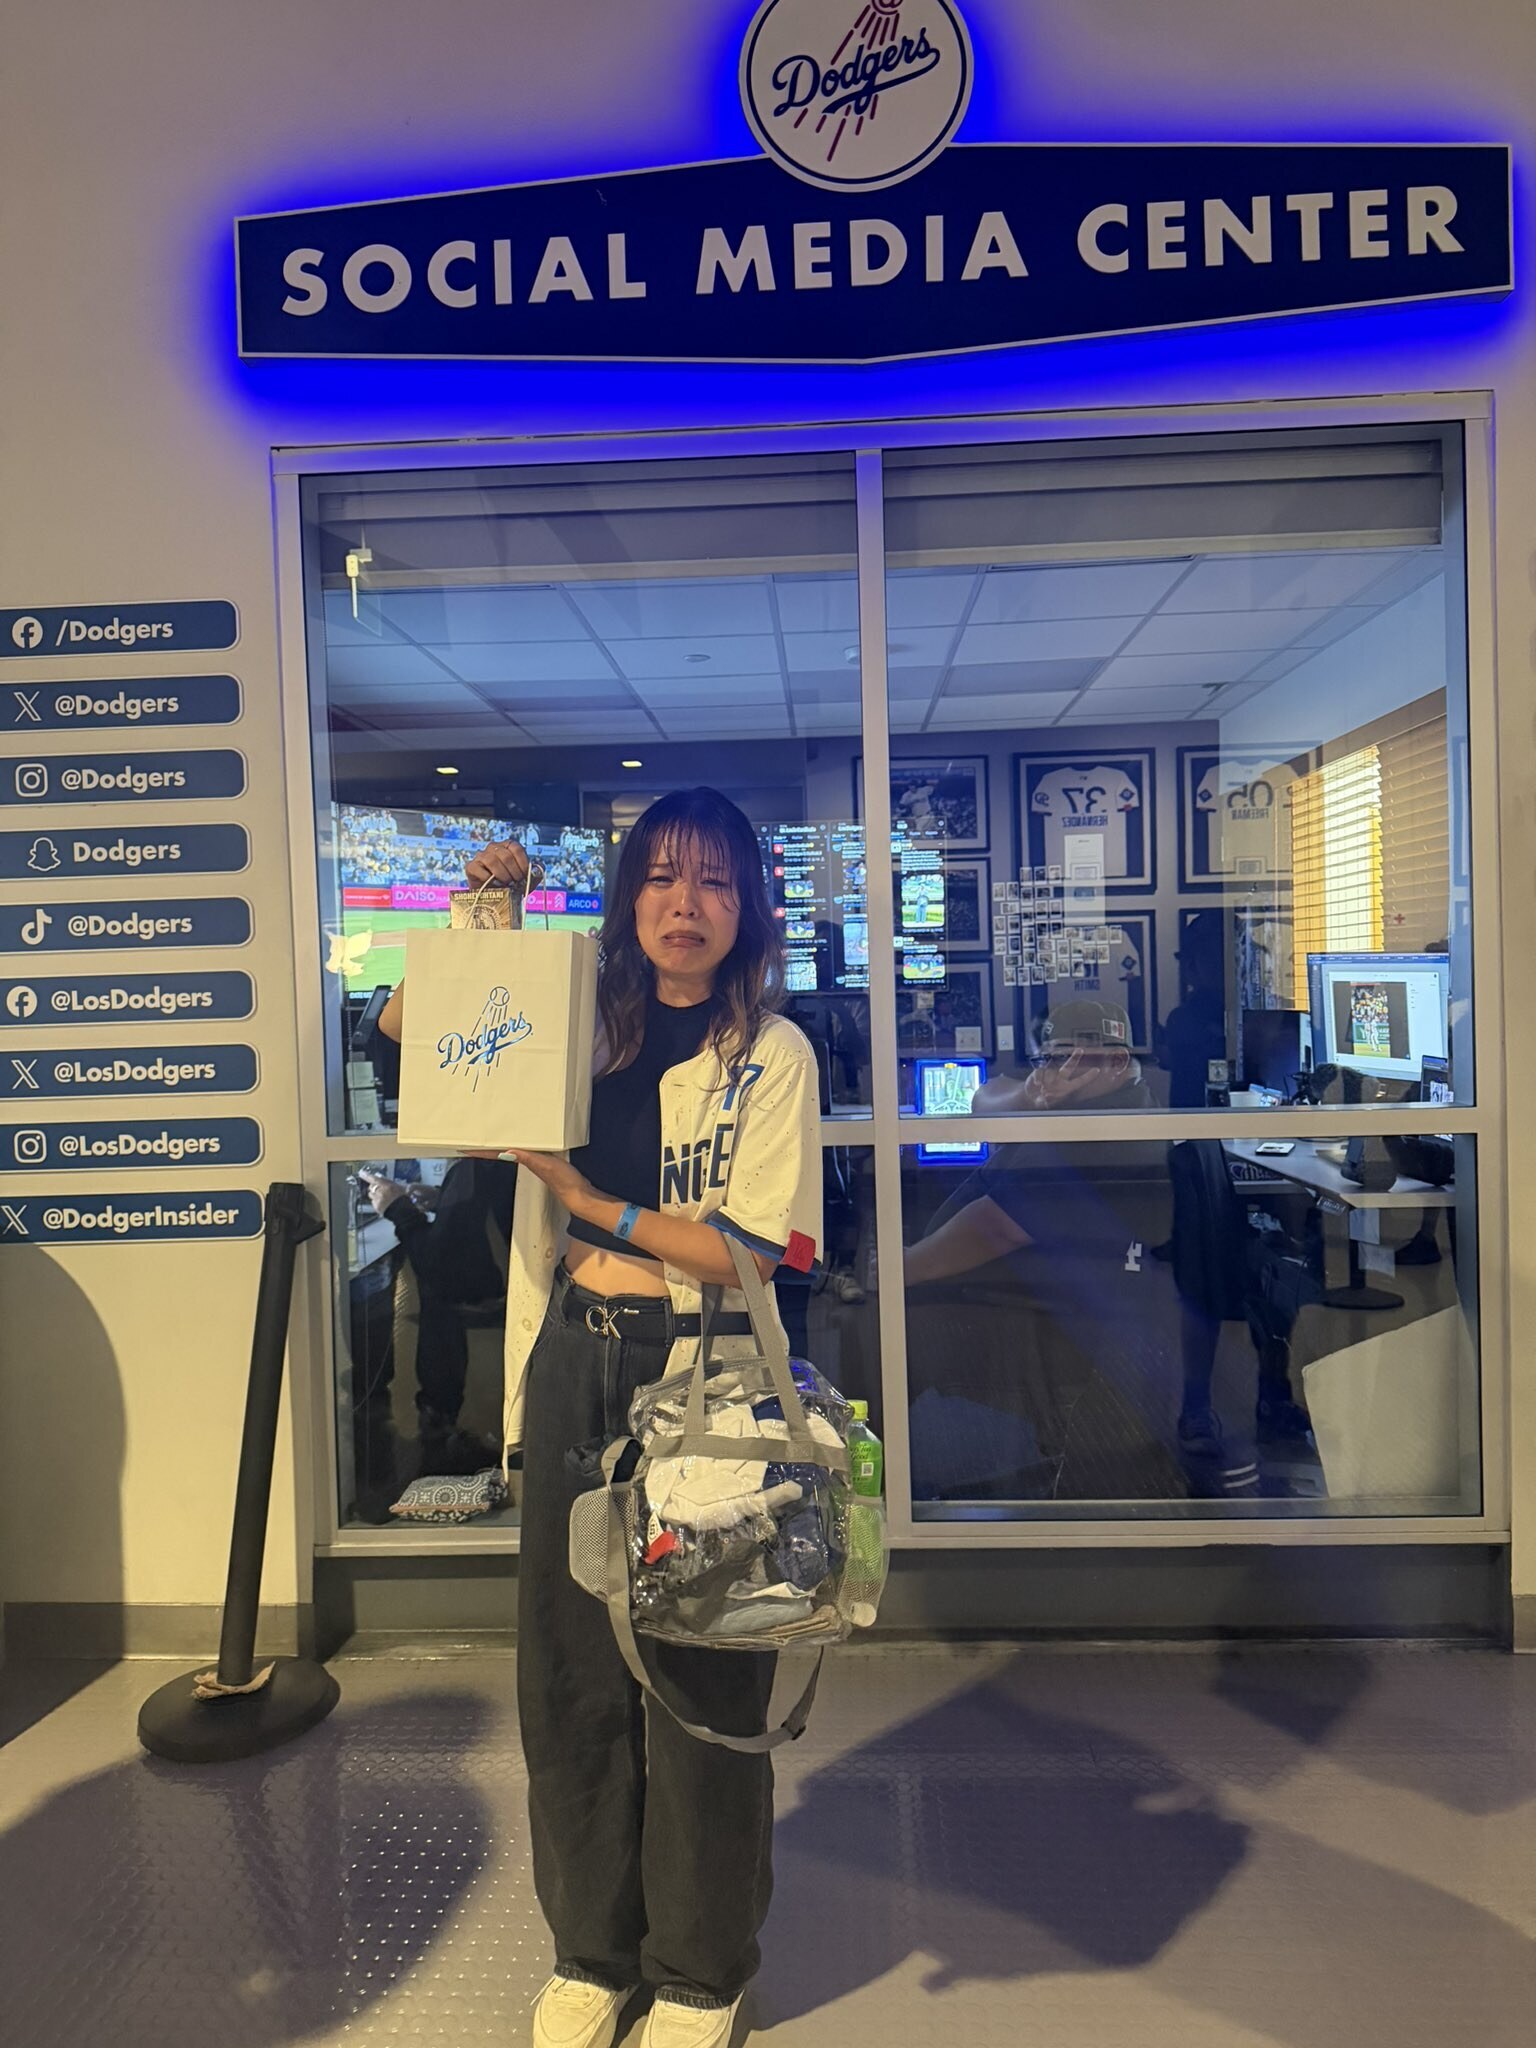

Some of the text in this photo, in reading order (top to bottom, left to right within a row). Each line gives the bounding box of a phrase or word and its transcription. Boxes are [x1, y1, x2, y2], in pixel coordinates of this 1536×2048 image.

[771, 26, 941, 118] Dodgers
[281, 185, 1465, 317] SOCIAL MEDIA CENTER
[55, 617, 174, 647] /Dodgers
[54, 691, 179, 720] @Dodgers
[61, 765, 186, 794] @Dodgers
[73, 838, 181, 867] Dodgers
[395, 890, 436, 902] DAISO
[568, 899, 592, 909] ARCO
[67, 912, 193, 940] @Dodgers
[51, 985, 213, 1014] @LosDodgers
[437, 1011, 533, 1069] Dodgers
[54, 1057, 216, 1086] @LosDodgers
[59, 1131, 221, 1160] @LosDodgers
[42, 1202, 239, 1234] @DodgerInsider
